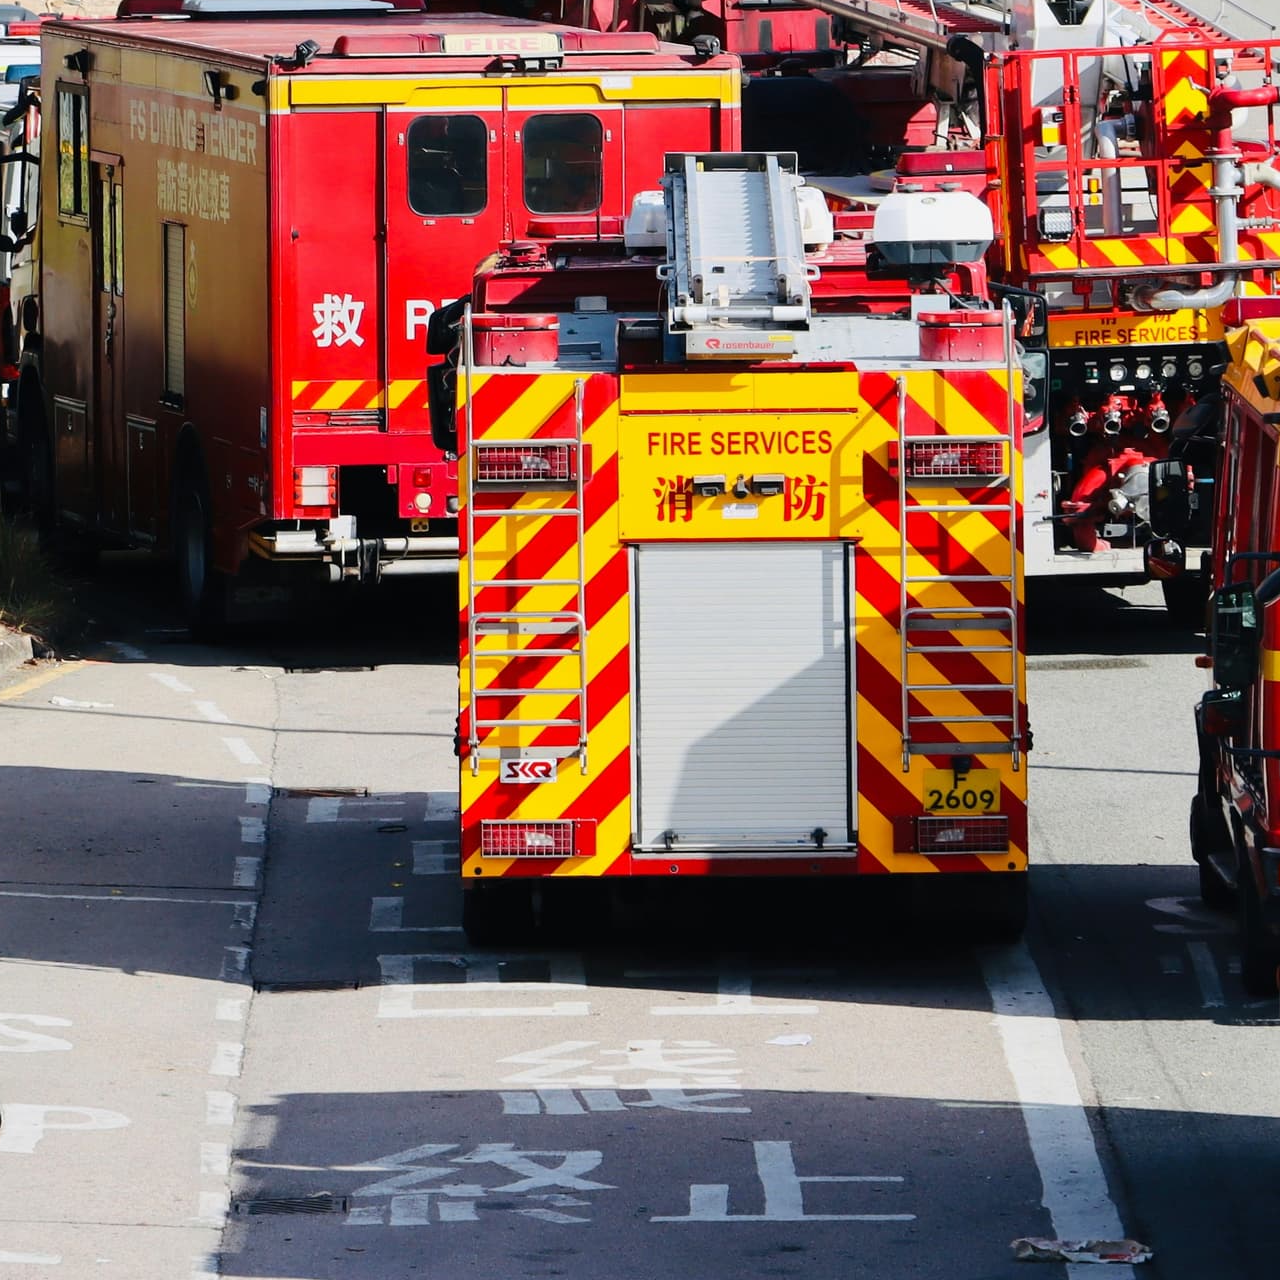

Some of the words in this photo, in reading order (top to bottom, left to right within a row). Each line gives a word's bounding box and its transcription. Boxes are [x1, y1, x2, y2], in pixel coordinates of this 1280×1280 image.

[465, 38, 541, 51] FIRE
[130, 99, 147, 142] FS
[150, 101, 197, 152] DIVING
[200, 111, 257, 166] TENDER
[311, 293, 365, 348] 救
[722, 340, 775, 350] rosenbauer
[1075, 328, 1112, 345] FIRE
[1117, 326, 1199, 345] SERVICES
[648, 432, 702, 456] FIRE
[710, 430, 833, 456] SERVICES
[928, 789, 995, 810] 2609
